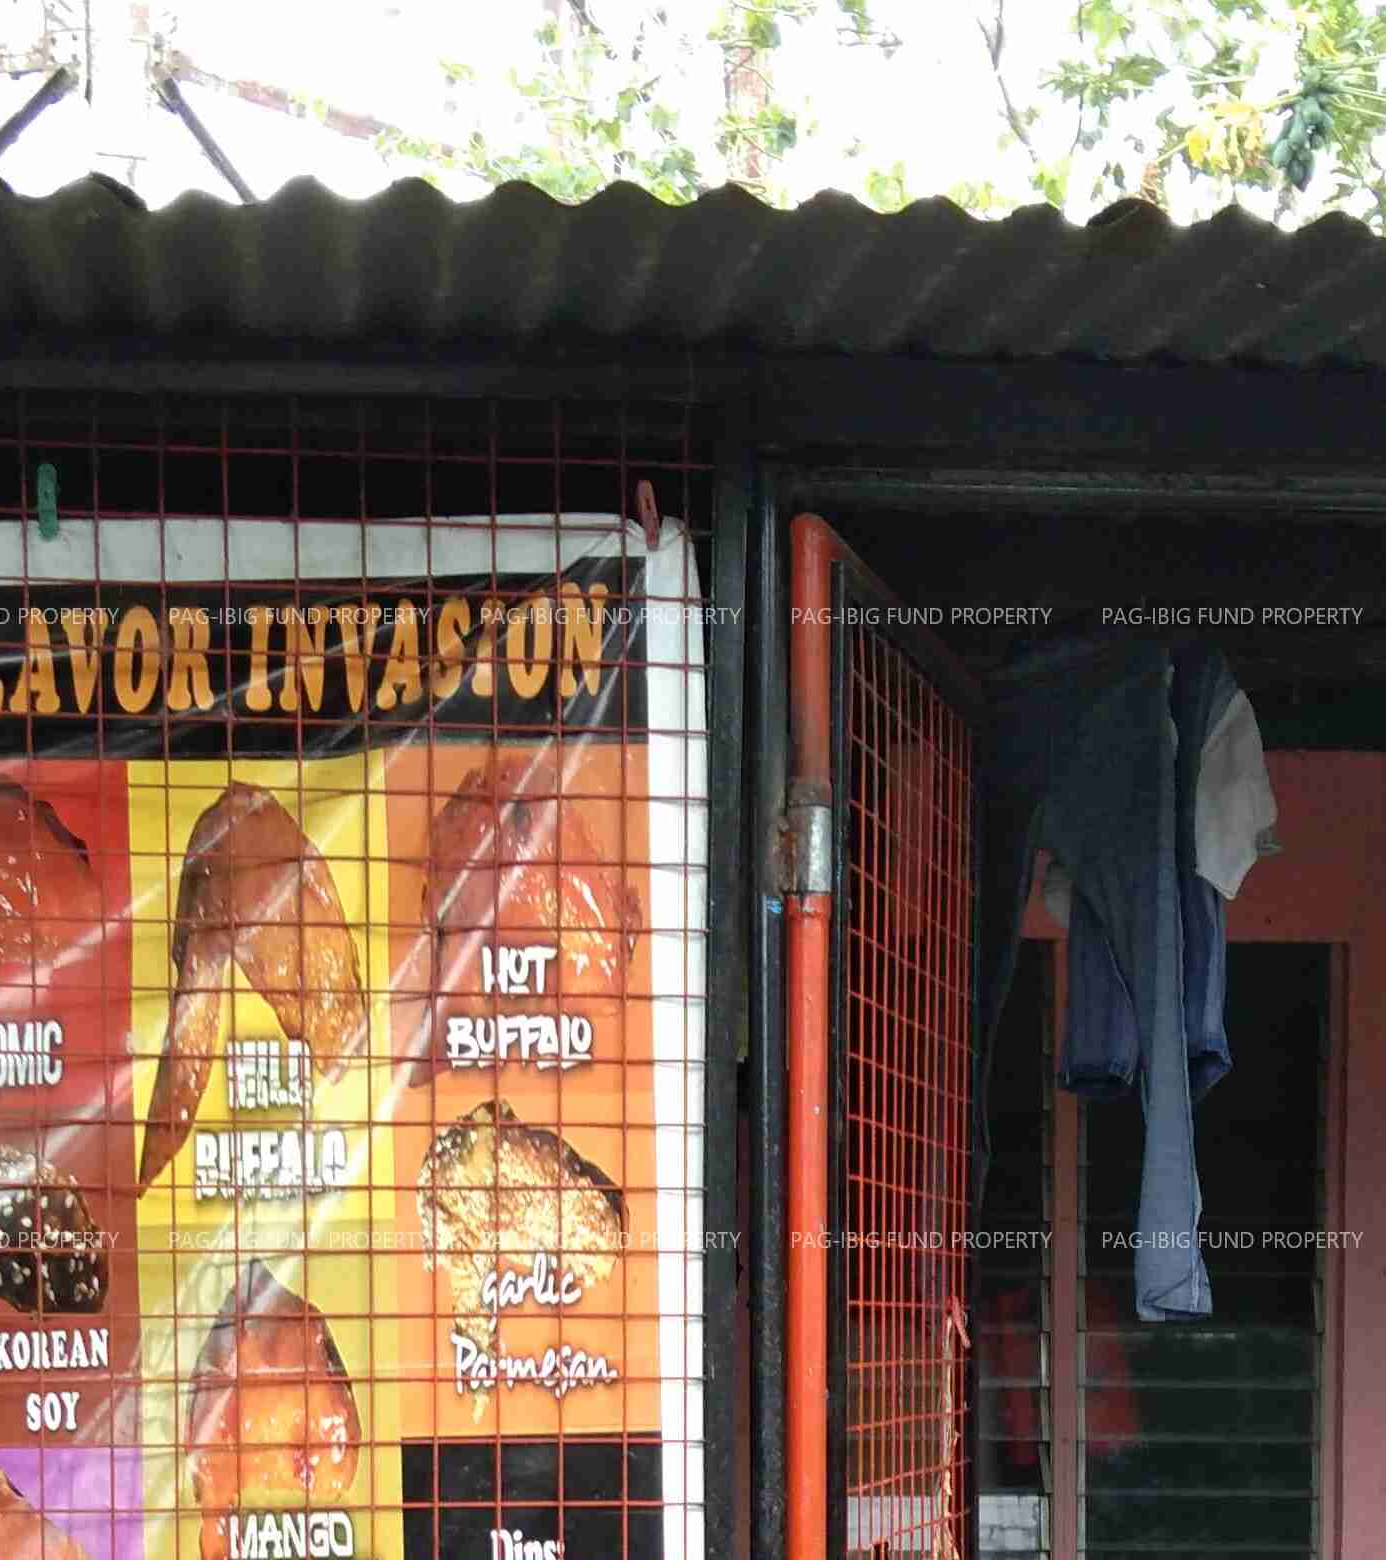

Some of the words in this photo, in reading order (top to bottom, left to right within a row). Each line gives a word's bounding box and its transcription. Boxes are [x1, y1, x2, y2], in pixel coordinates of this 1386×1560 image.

[245, 582, 610, 712] INVASION
[482, 946, 557, 995] HOT
[447, 1014, 593, 1070] BUFFALO
[196, 1130, 347, 1200] BUFFALO
[482, 1252, 581, 1332] garlic
[26, 1390, 80, 1432] SOY
[228, 1512, 354, 1559] MANGO
